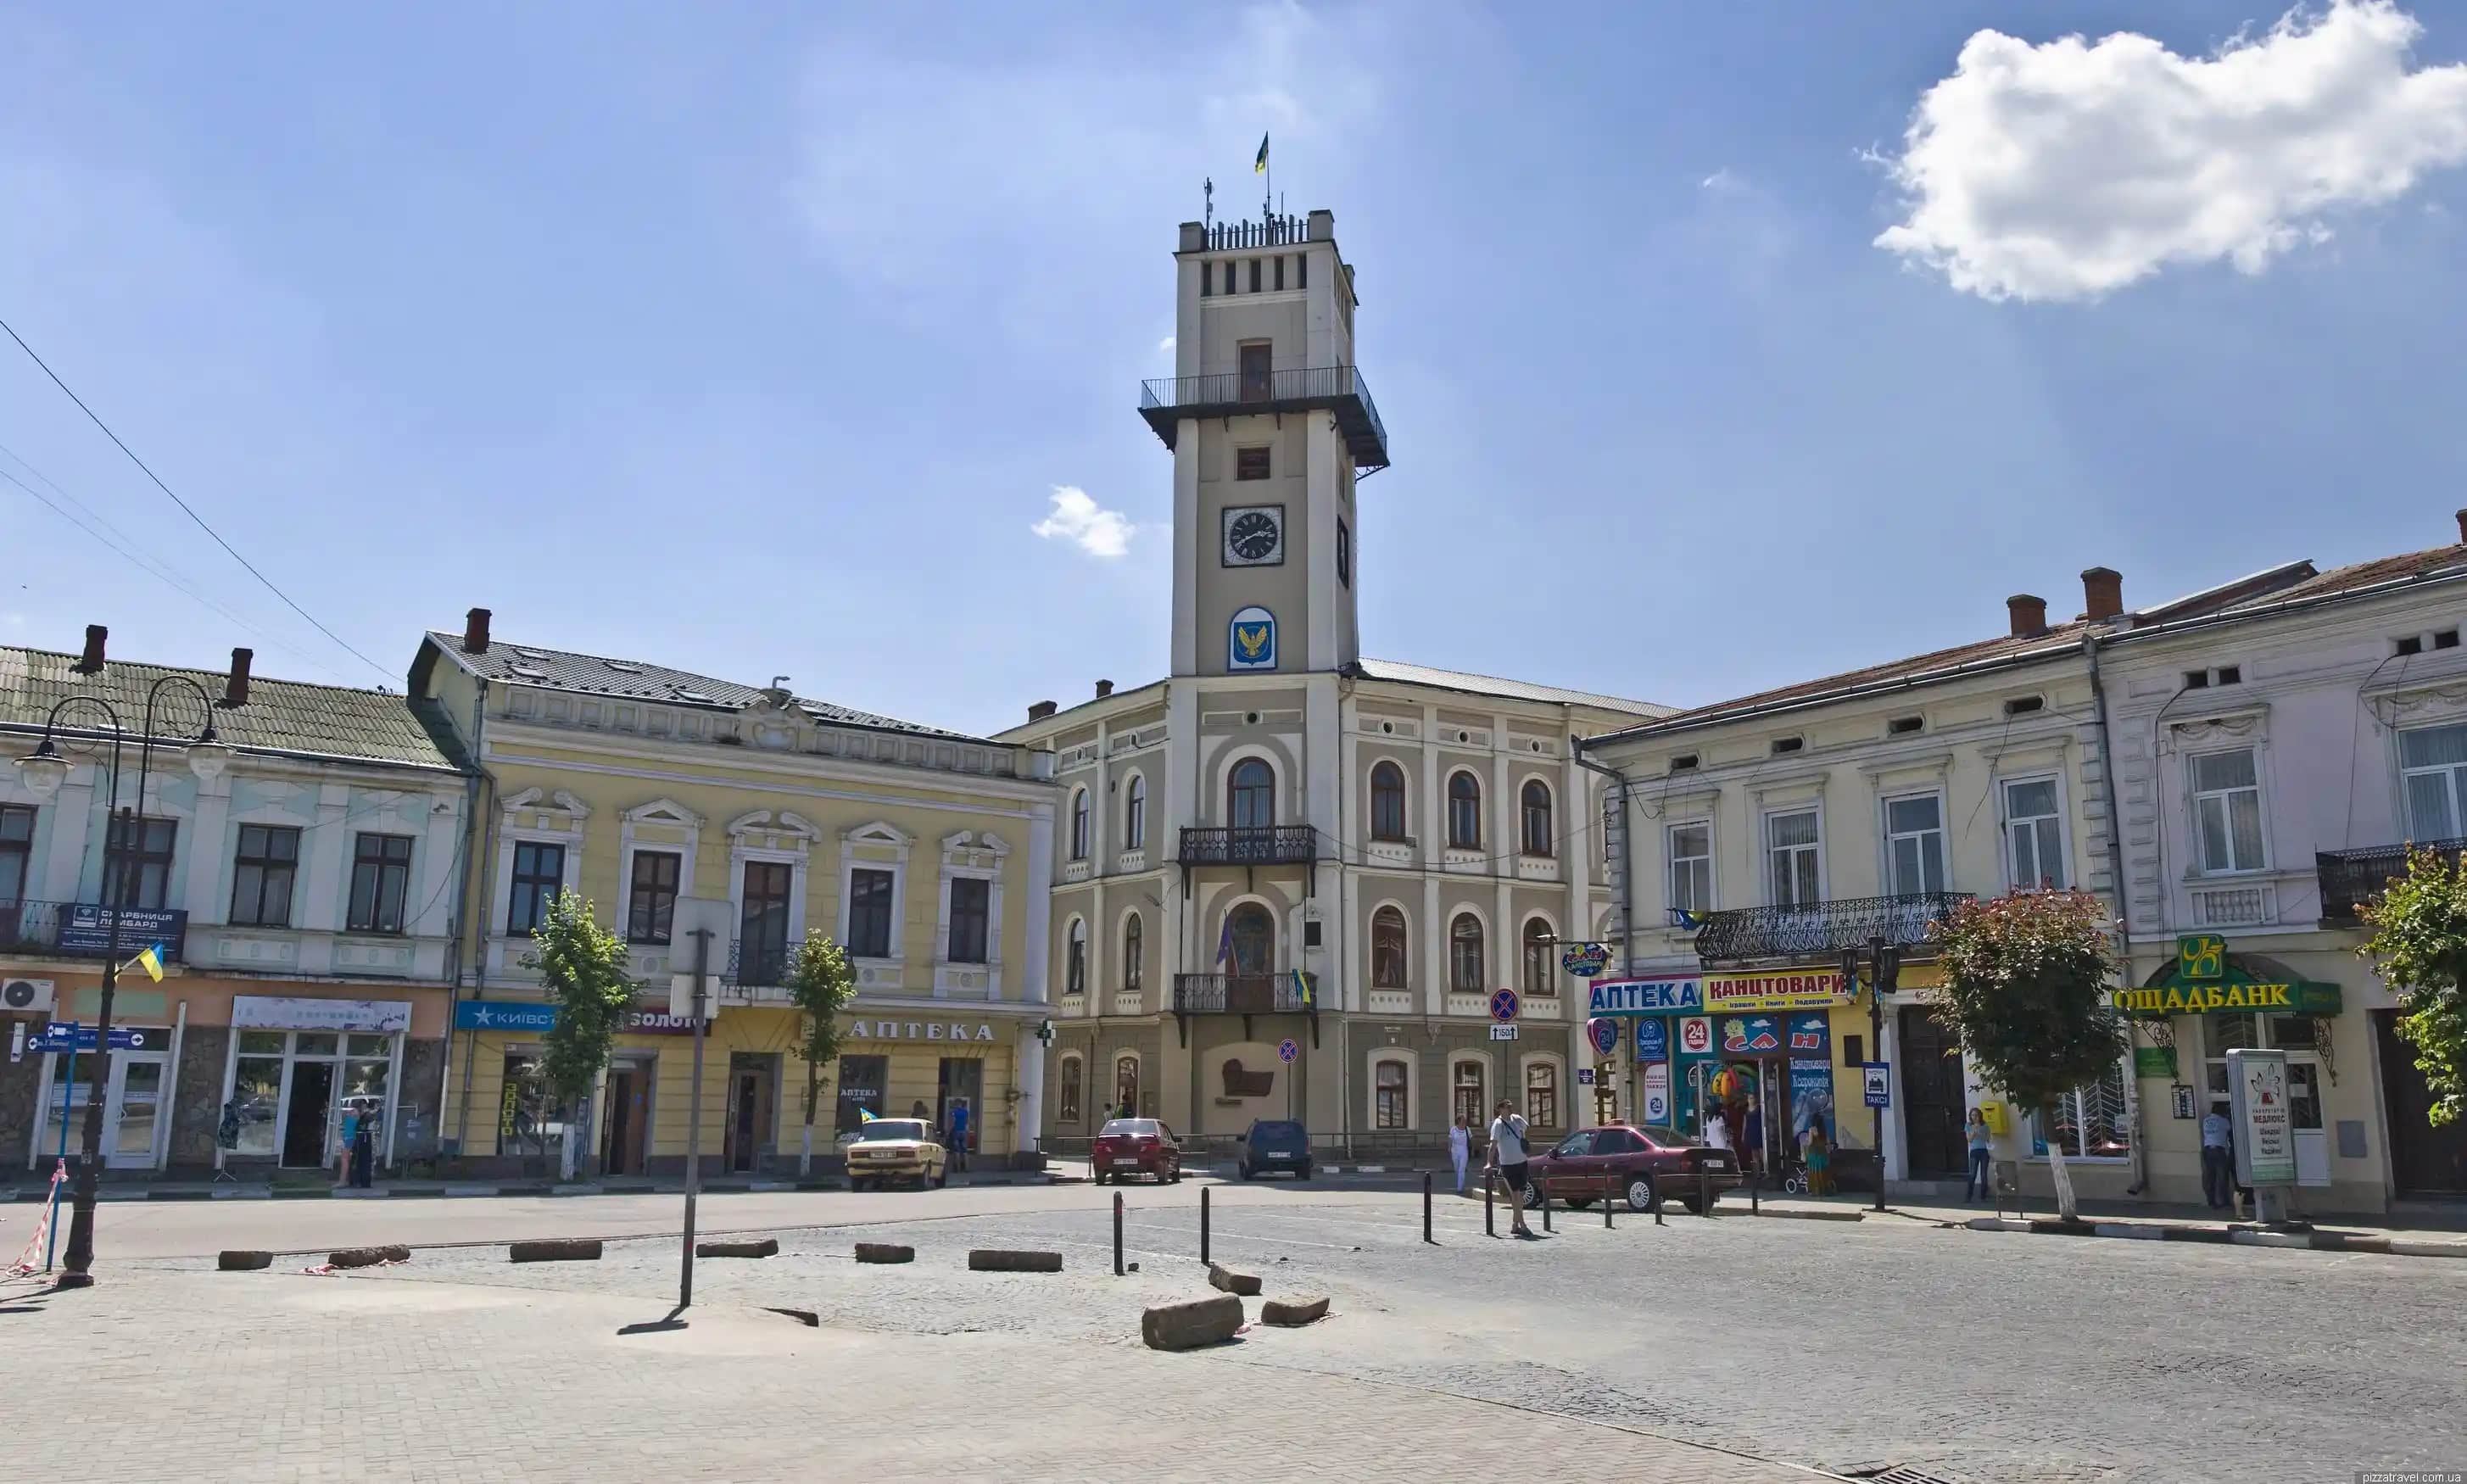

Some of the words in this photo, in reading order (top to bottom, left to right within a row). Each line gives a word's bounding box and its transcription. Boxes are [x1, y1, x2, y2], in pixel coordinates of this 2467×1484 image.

[1709, 974, 1847, 1000] КАНЦТОВАРИ
[1589, 982, 1698, 1009] АПТЕКА
[2113, 984, 2291, 1013] ОЩАДБАНК
[849, 1020, 995, 1041] АПТЕКА
[1688, 1024, 1705, 1039] 24
[840, 1088, 878, 1097] АПТЕКА
[1651, 1099, 1660, 1108] 24
[1867, 1096, 1888, 1105] ТАКСІ
[2252, 1114, 2286, 1124] МЕДЛЮКС
